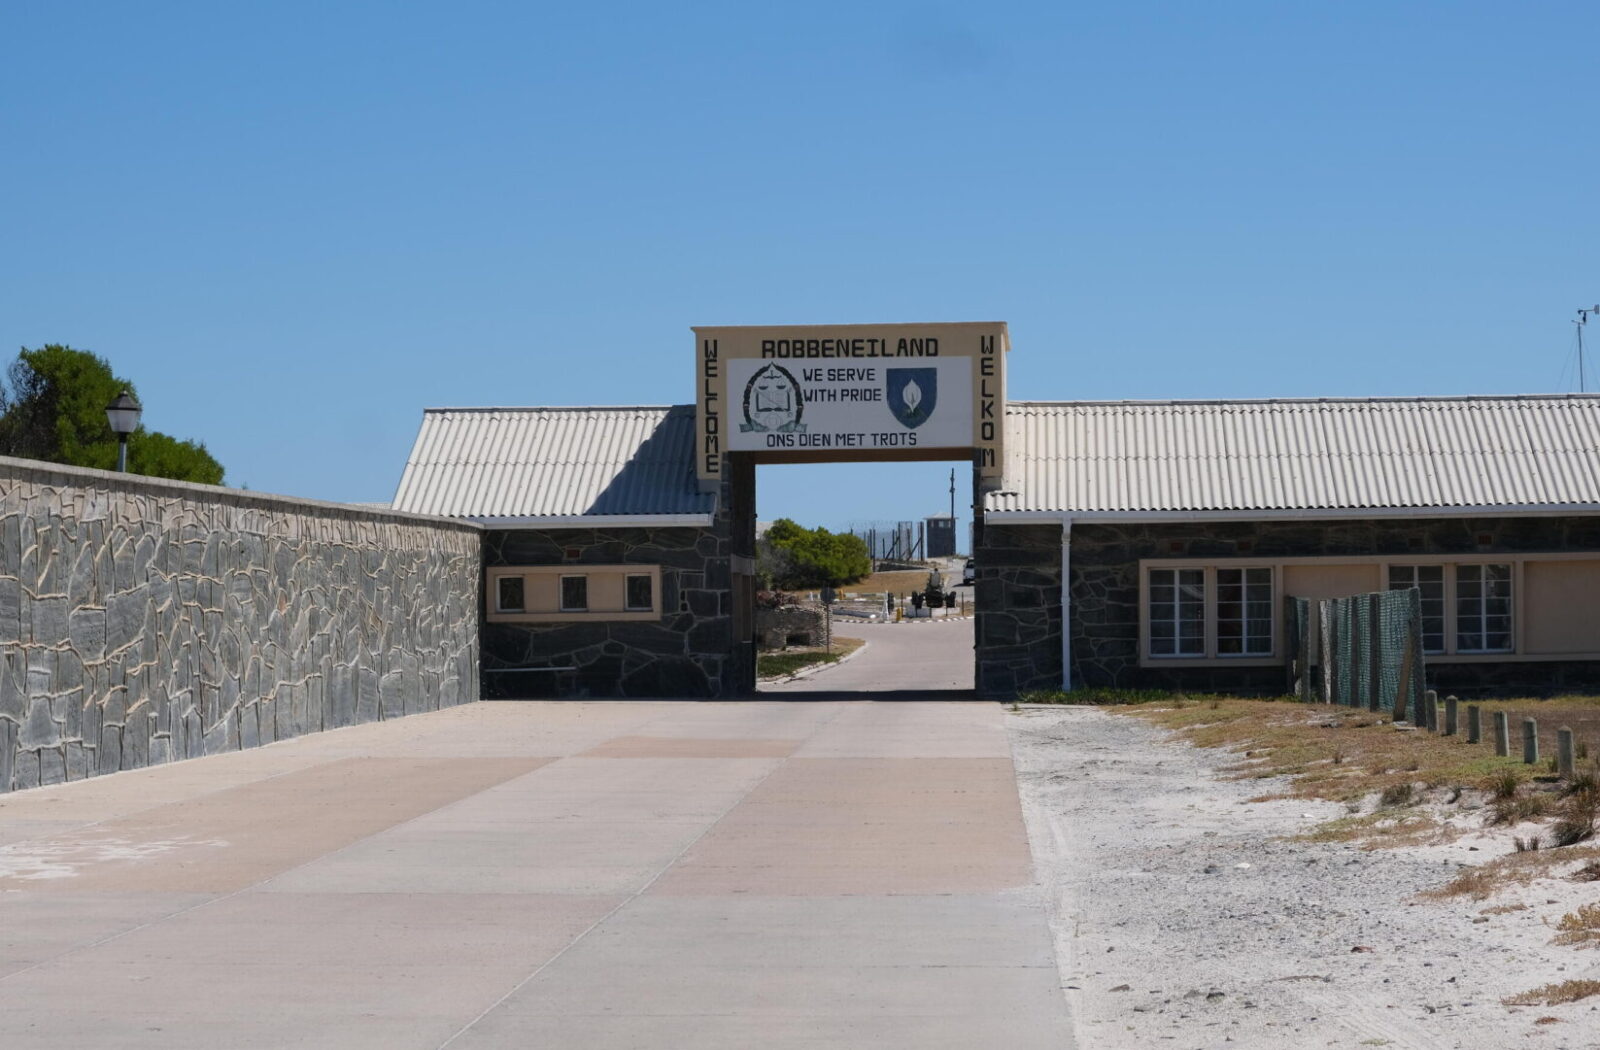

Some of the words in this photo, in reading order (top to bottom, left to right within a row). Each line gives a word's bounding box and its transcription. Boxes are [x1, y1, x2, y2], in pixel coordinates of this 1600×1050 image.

[761, 338, 939, 358] ROBBENEILAND
[803, 368, 823, 382] WE
[827, 368, 875, 382] SERVE
[803, 388, 837, 402] WITH
[840, 388, 882, 402] PRIDE
[981, 335, 995, 467] WELKOM
[704, 339, 718, 472] WELCOME
[766, 434, 795, 447] ONS
[799, 433, 831, 447] DIEN
[835, 433, 866, 446] MET
[870, 432, 917, 446] TROTS
